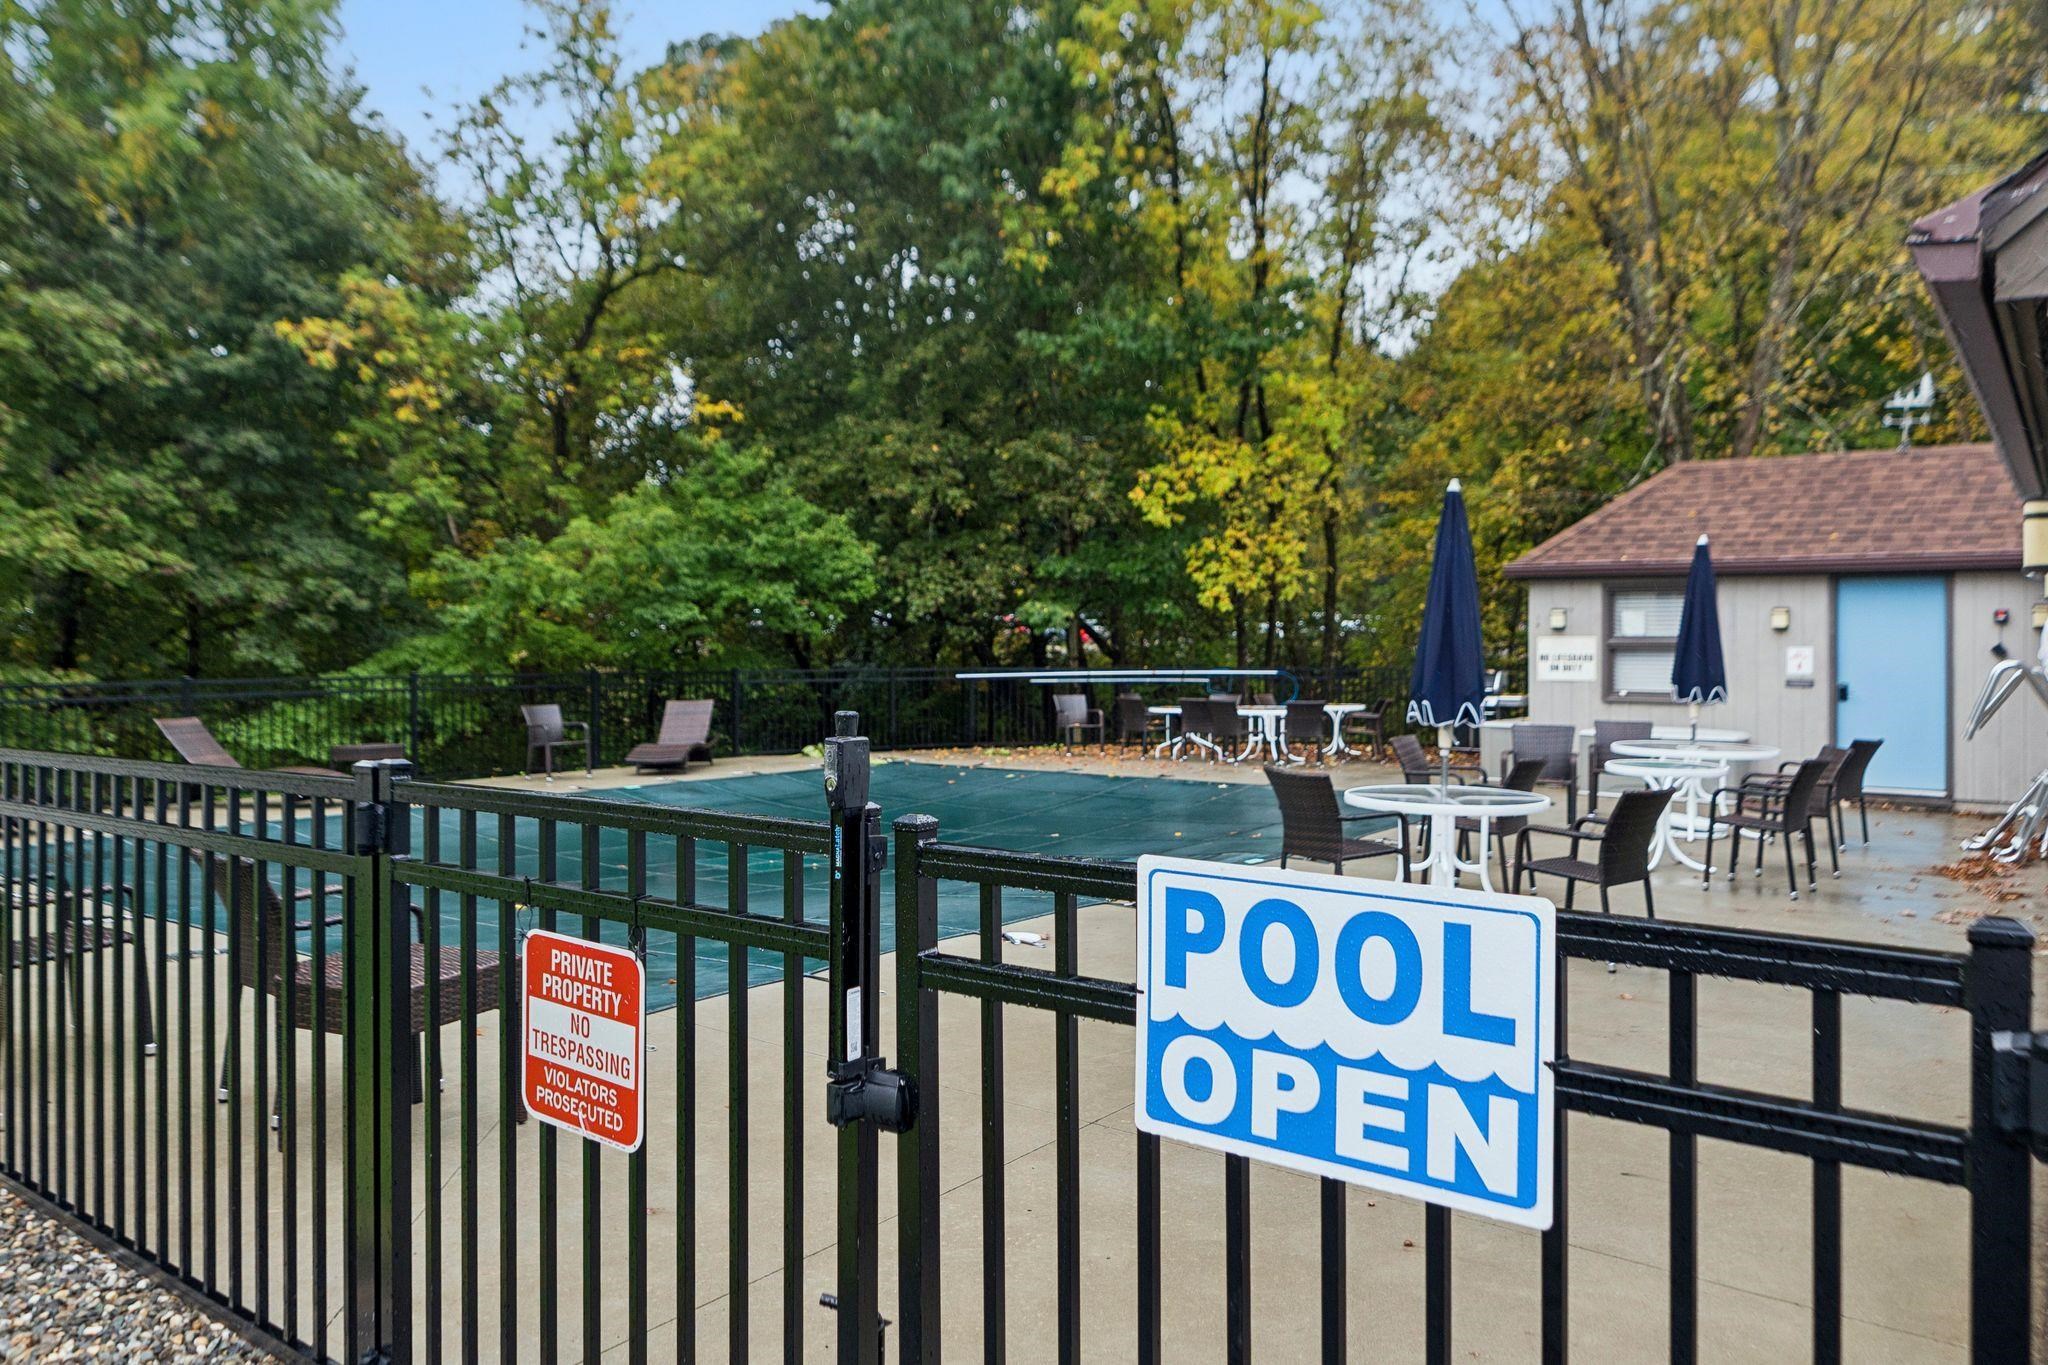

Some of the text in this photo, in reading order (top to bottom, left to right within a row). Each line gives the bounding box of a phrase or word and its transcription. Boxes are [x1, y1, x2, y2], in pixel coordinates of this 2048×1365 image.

[551, 949, 613, 987] PRIVATE
[1165, 886, 1516, 1047] POOL
[542, 973, 622, 1017] PROPERTY
[570, 1012, 590, 1039] NO
[532, 1028, 630, 1080] TRESPASSING
[536, 1086, 623, 1132] PROSECUTED
[543, 1066, 618, 1107] VIOLATORS
[1161, 1034, 1519, 1198] OPEN
